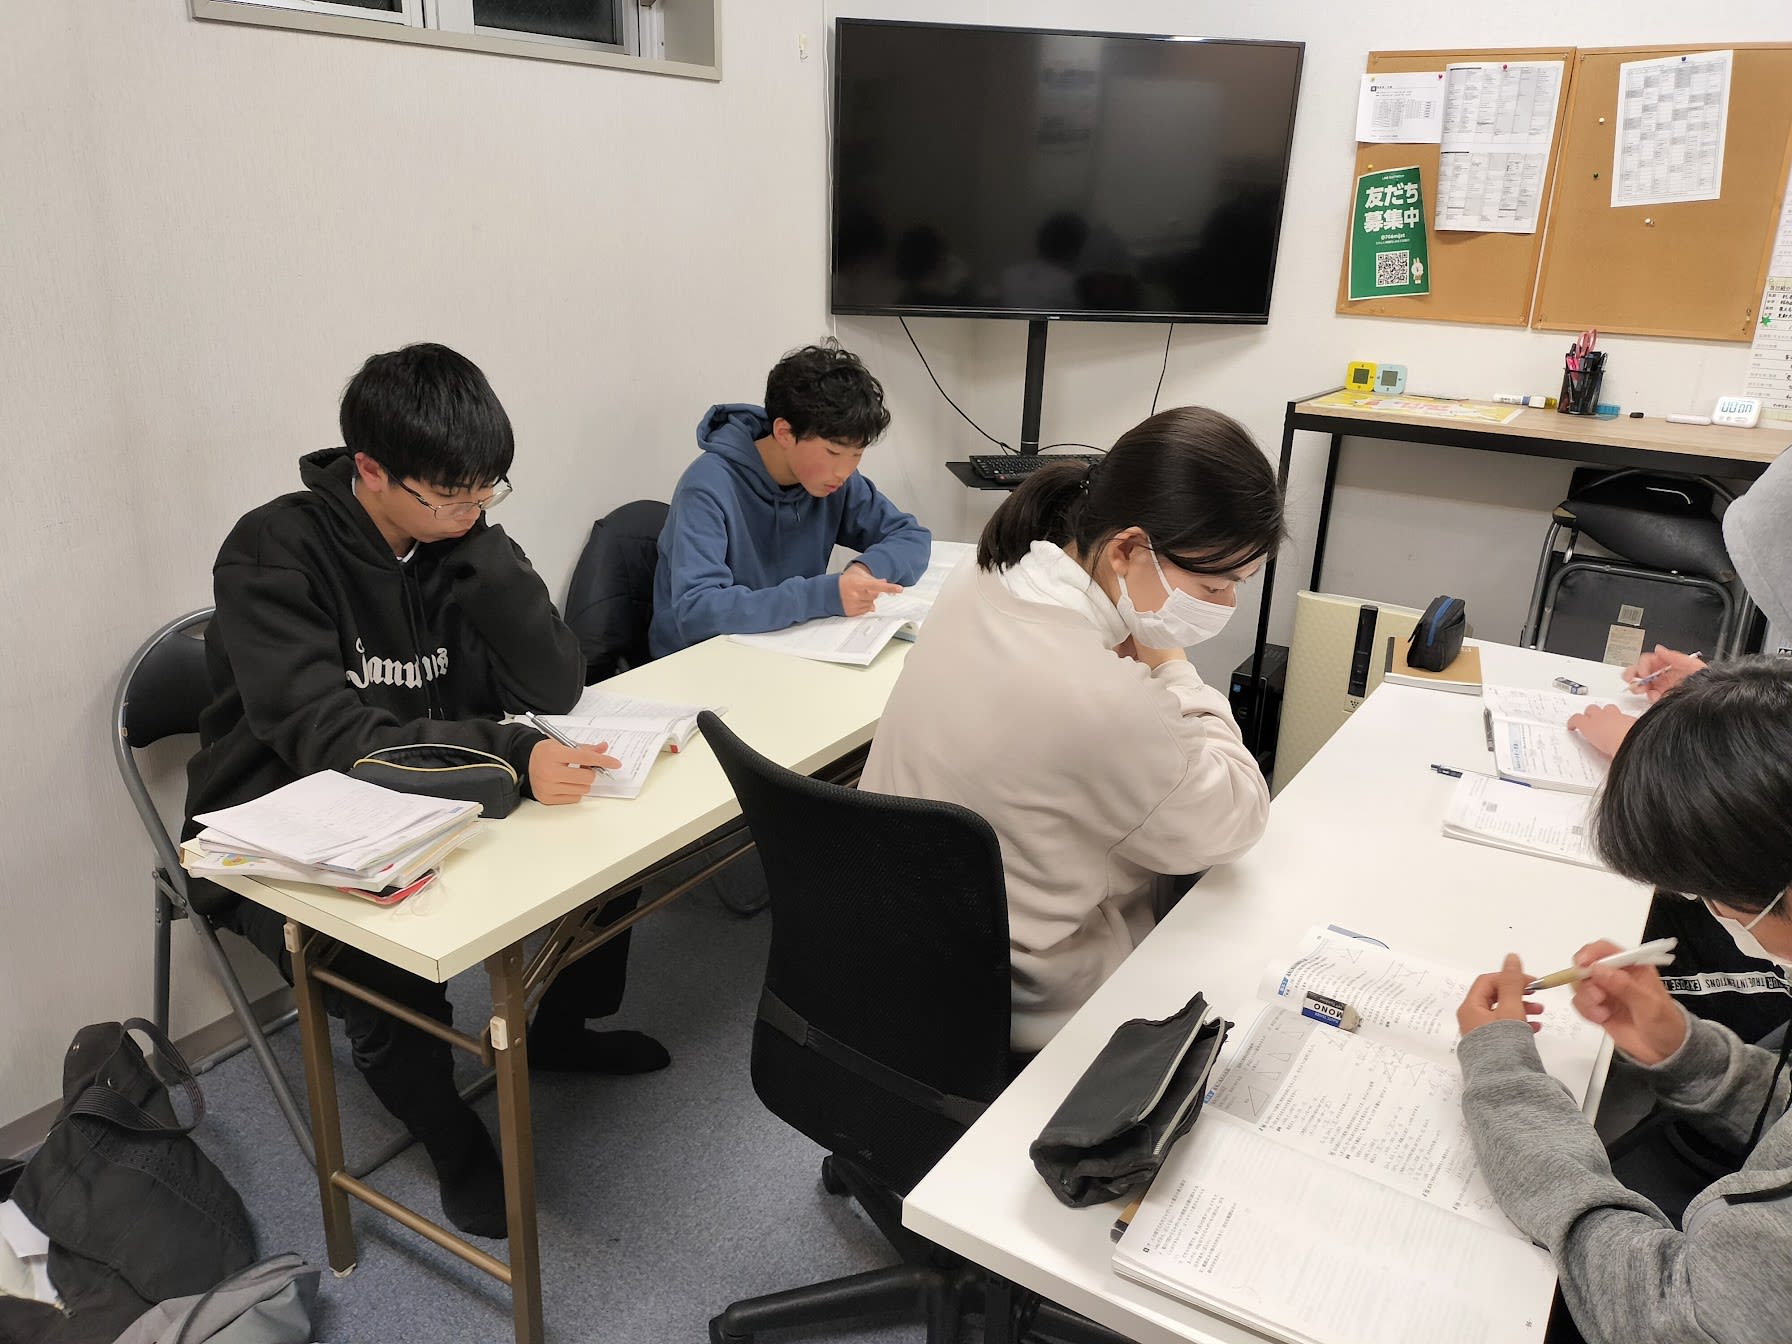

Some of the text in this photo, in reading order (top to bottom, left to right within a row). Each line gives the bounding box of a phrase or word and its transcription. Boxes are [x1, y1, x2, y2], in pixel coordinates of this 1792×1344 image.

[1365, 182, 1418, 208] 友だち
[1363, 207, 1419, 233] 募集中
[1671, 979, 1700, 991] EXPOSE
[1706, 978, 1748, 989] INTENTIONS
[1313, 1003, 1343, 1018] MONO
